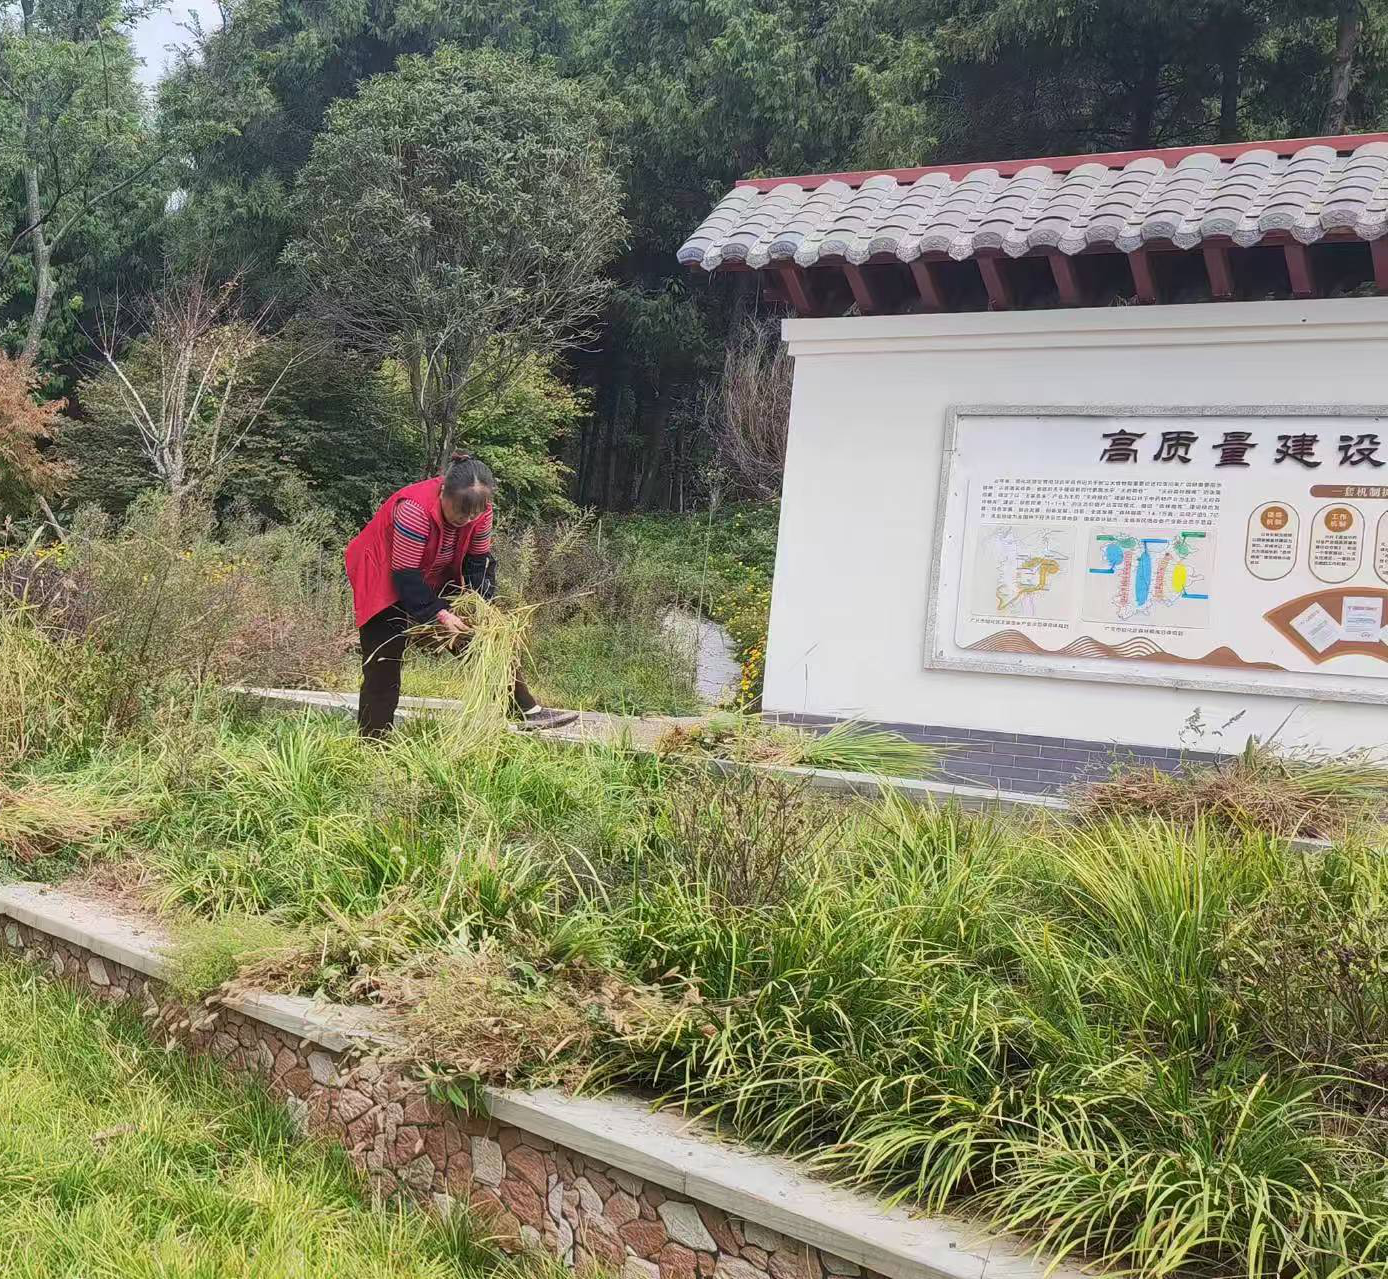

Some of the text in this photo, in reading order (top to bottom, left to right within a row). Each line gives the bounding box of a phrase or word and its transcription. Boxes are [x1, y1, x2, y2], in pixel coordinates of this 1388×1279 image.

[1099, 429, 1387, 468] 高质量建设
